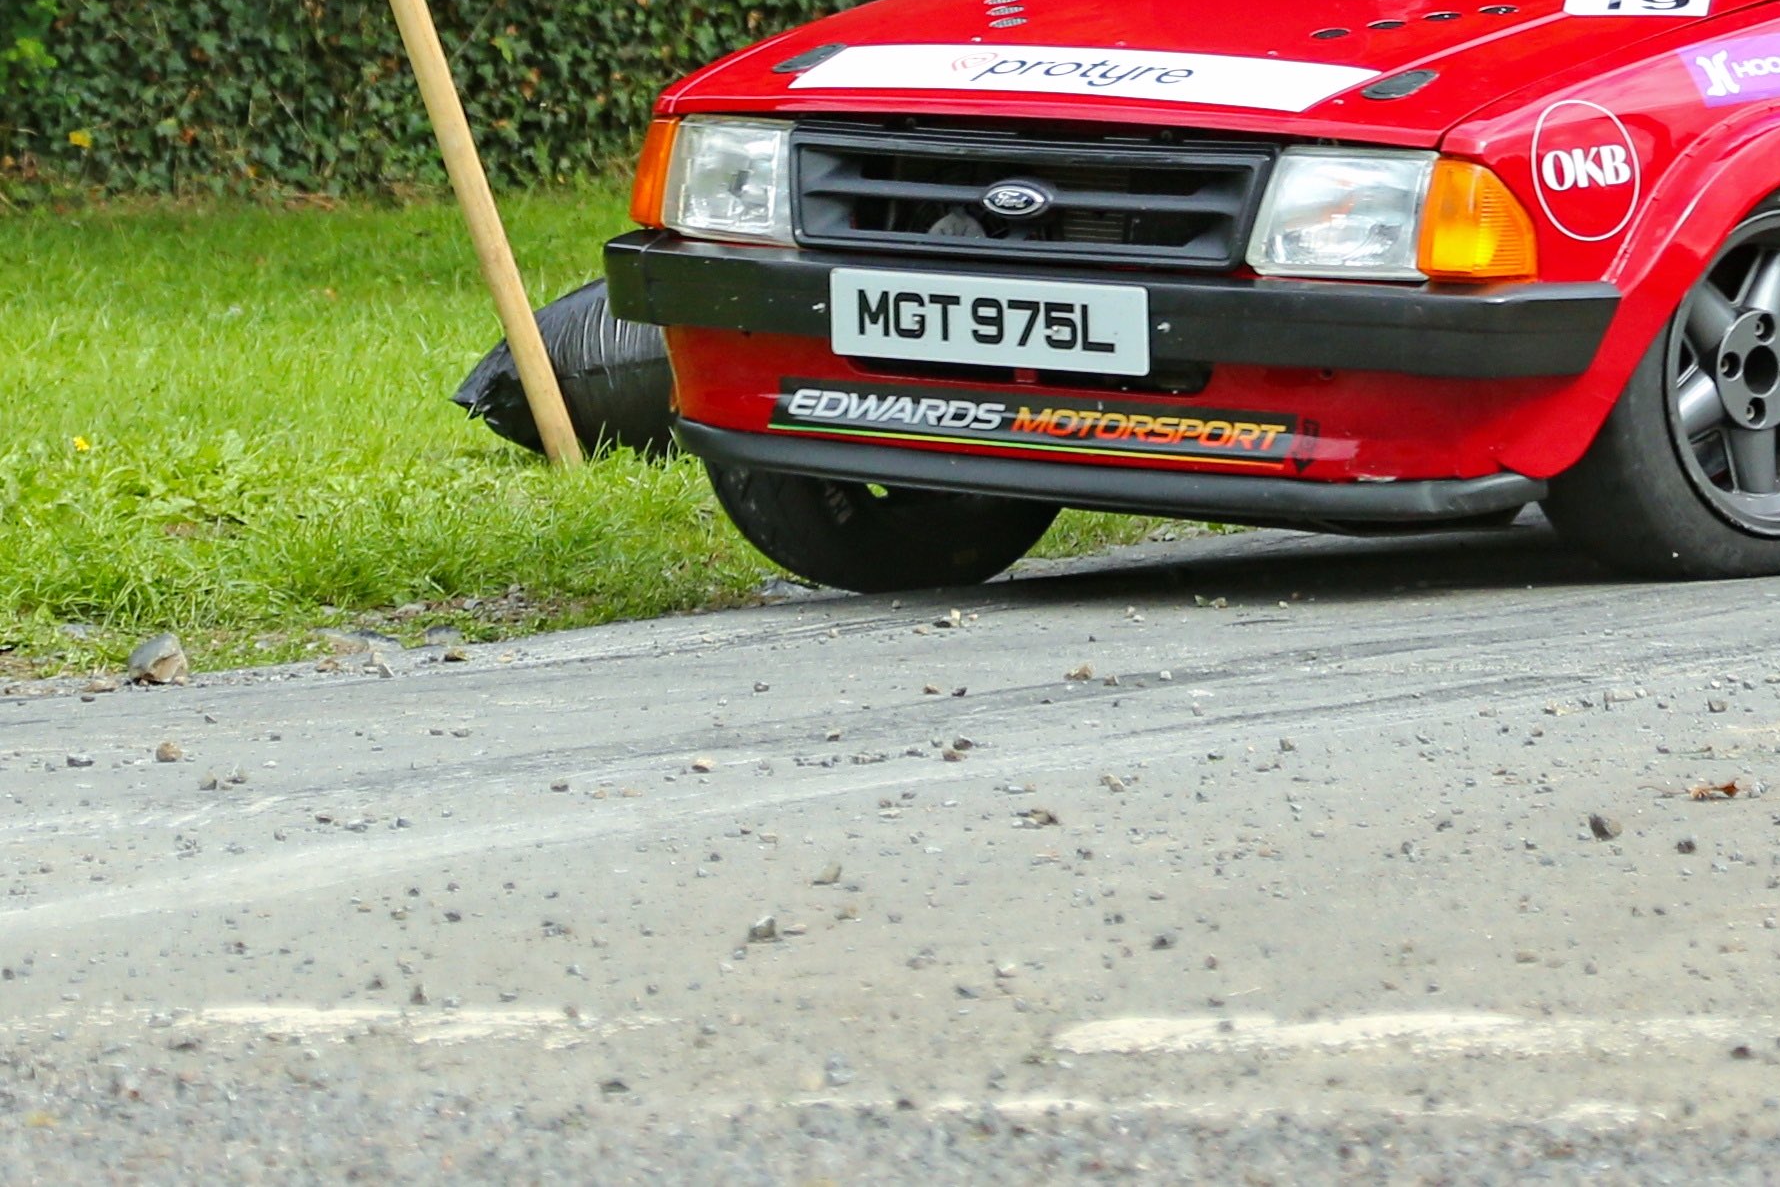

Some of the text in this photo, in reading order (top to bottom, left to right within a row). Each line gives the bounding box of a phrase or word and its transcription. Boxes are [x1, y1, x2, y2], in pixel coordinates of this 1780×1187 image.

[970, 59, 1194, 87] protyre
[1541, 144, 1631, 191] OKB
[858, 289, 1115, 354] MGT 975L
[788, 388, 1006, 431] EDWARDS
[1011, 406, 1287, 451] MOTORSPORT
